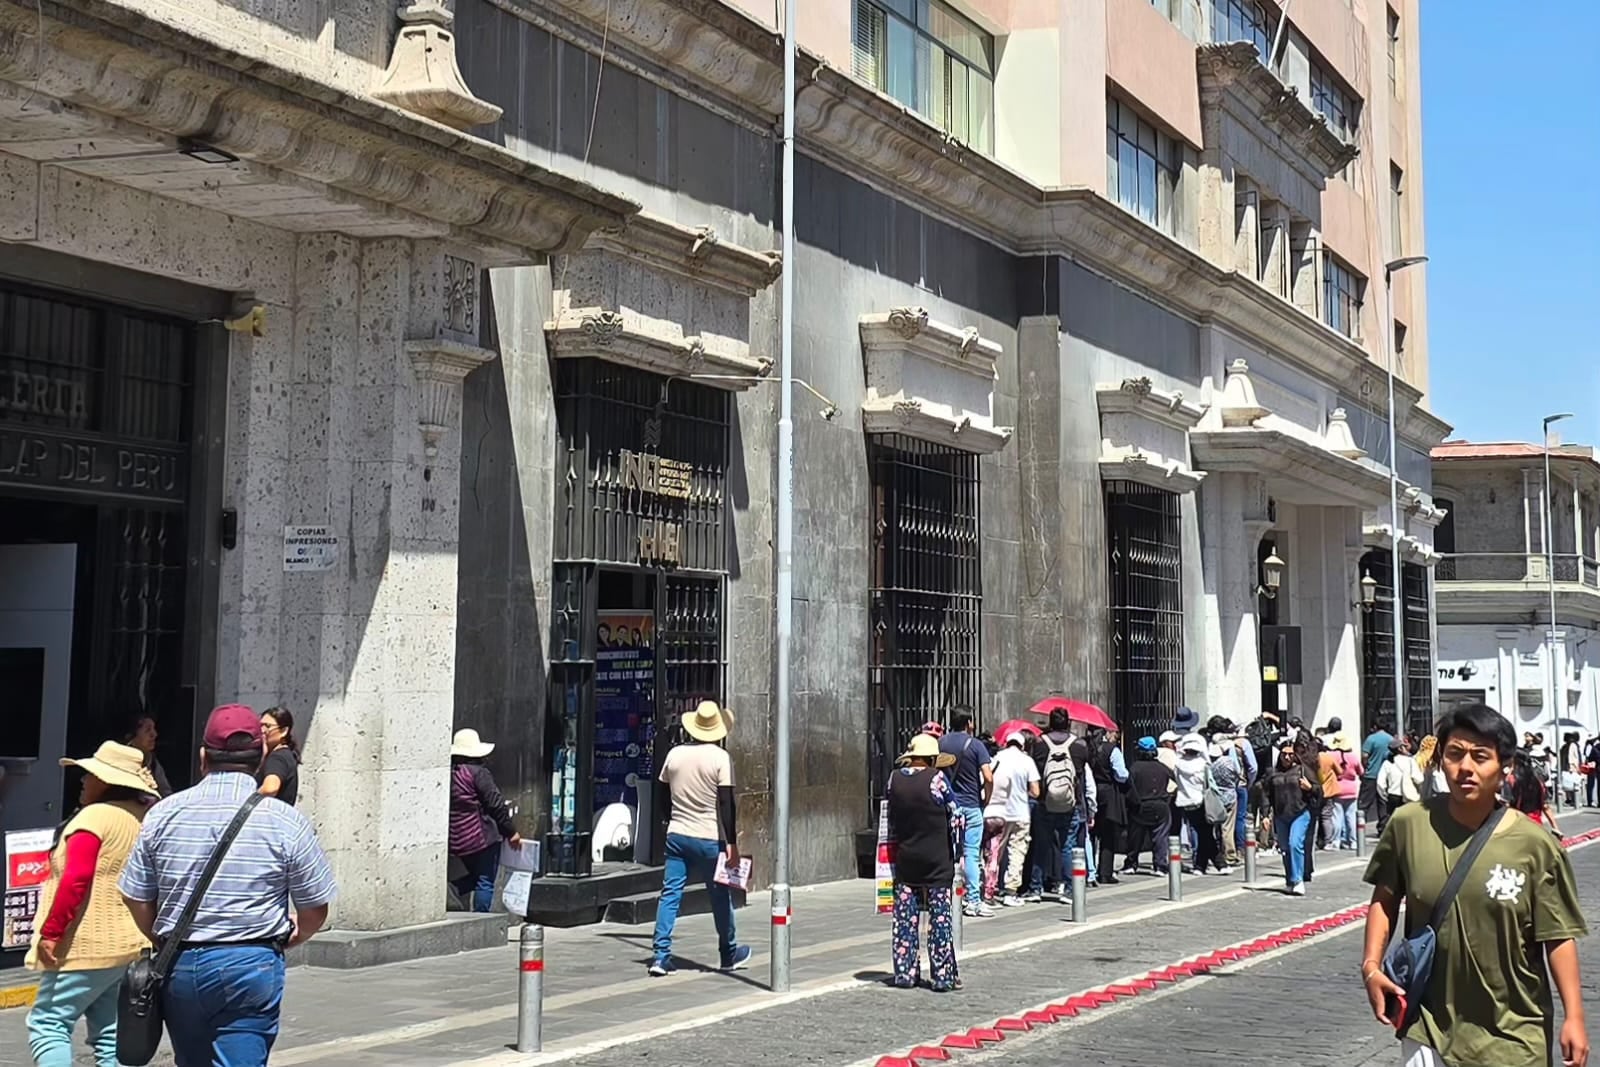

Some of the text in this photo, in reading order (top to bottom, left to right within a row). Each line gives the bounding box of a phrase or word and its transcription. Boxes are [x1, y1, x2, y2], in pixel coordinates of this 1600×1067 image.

[58, 443, 107, 484] DEL
[297, 528, 326, 536] COPIAS
[285, 537, 338, 545] IMPRESIONES
